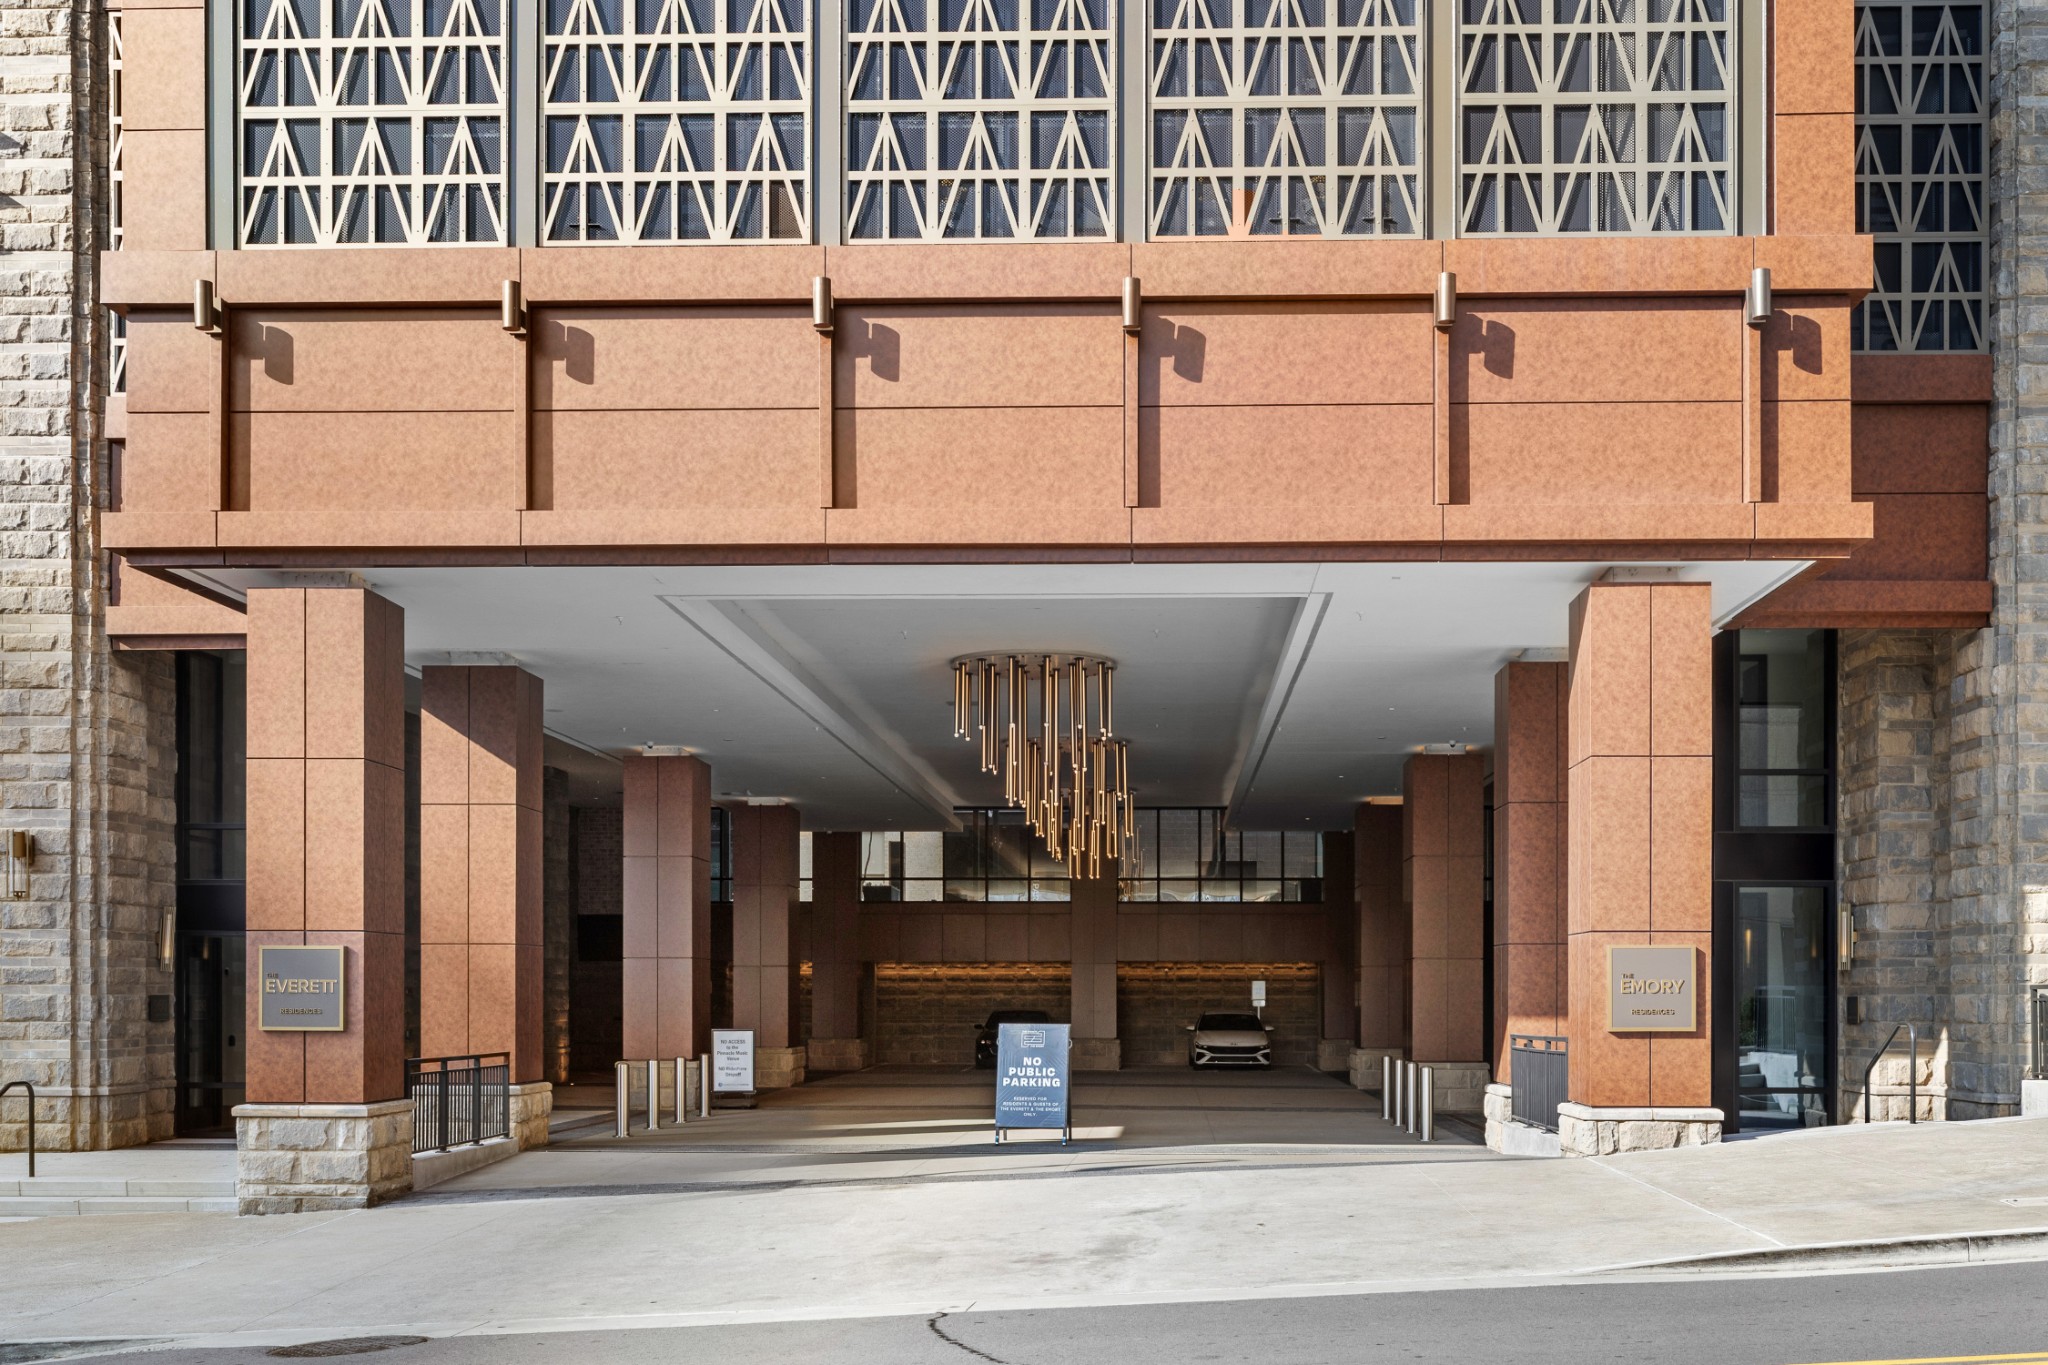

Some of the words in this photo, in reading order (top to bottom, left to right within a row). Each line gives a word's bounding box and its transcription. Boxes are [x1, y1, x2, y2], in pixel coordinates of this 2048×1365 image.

[265, 978, 338, 994] EVERETT
[1620, 979, 1686, 994] EMORY
[280, 1007, 323, 1015] RESIDENCES
[1023, 1056, 1042, 1066] NO
[1008, 1066, 1056, 1077] PUBLIC
[1002, 1077, 1061, 1087] PARKING
